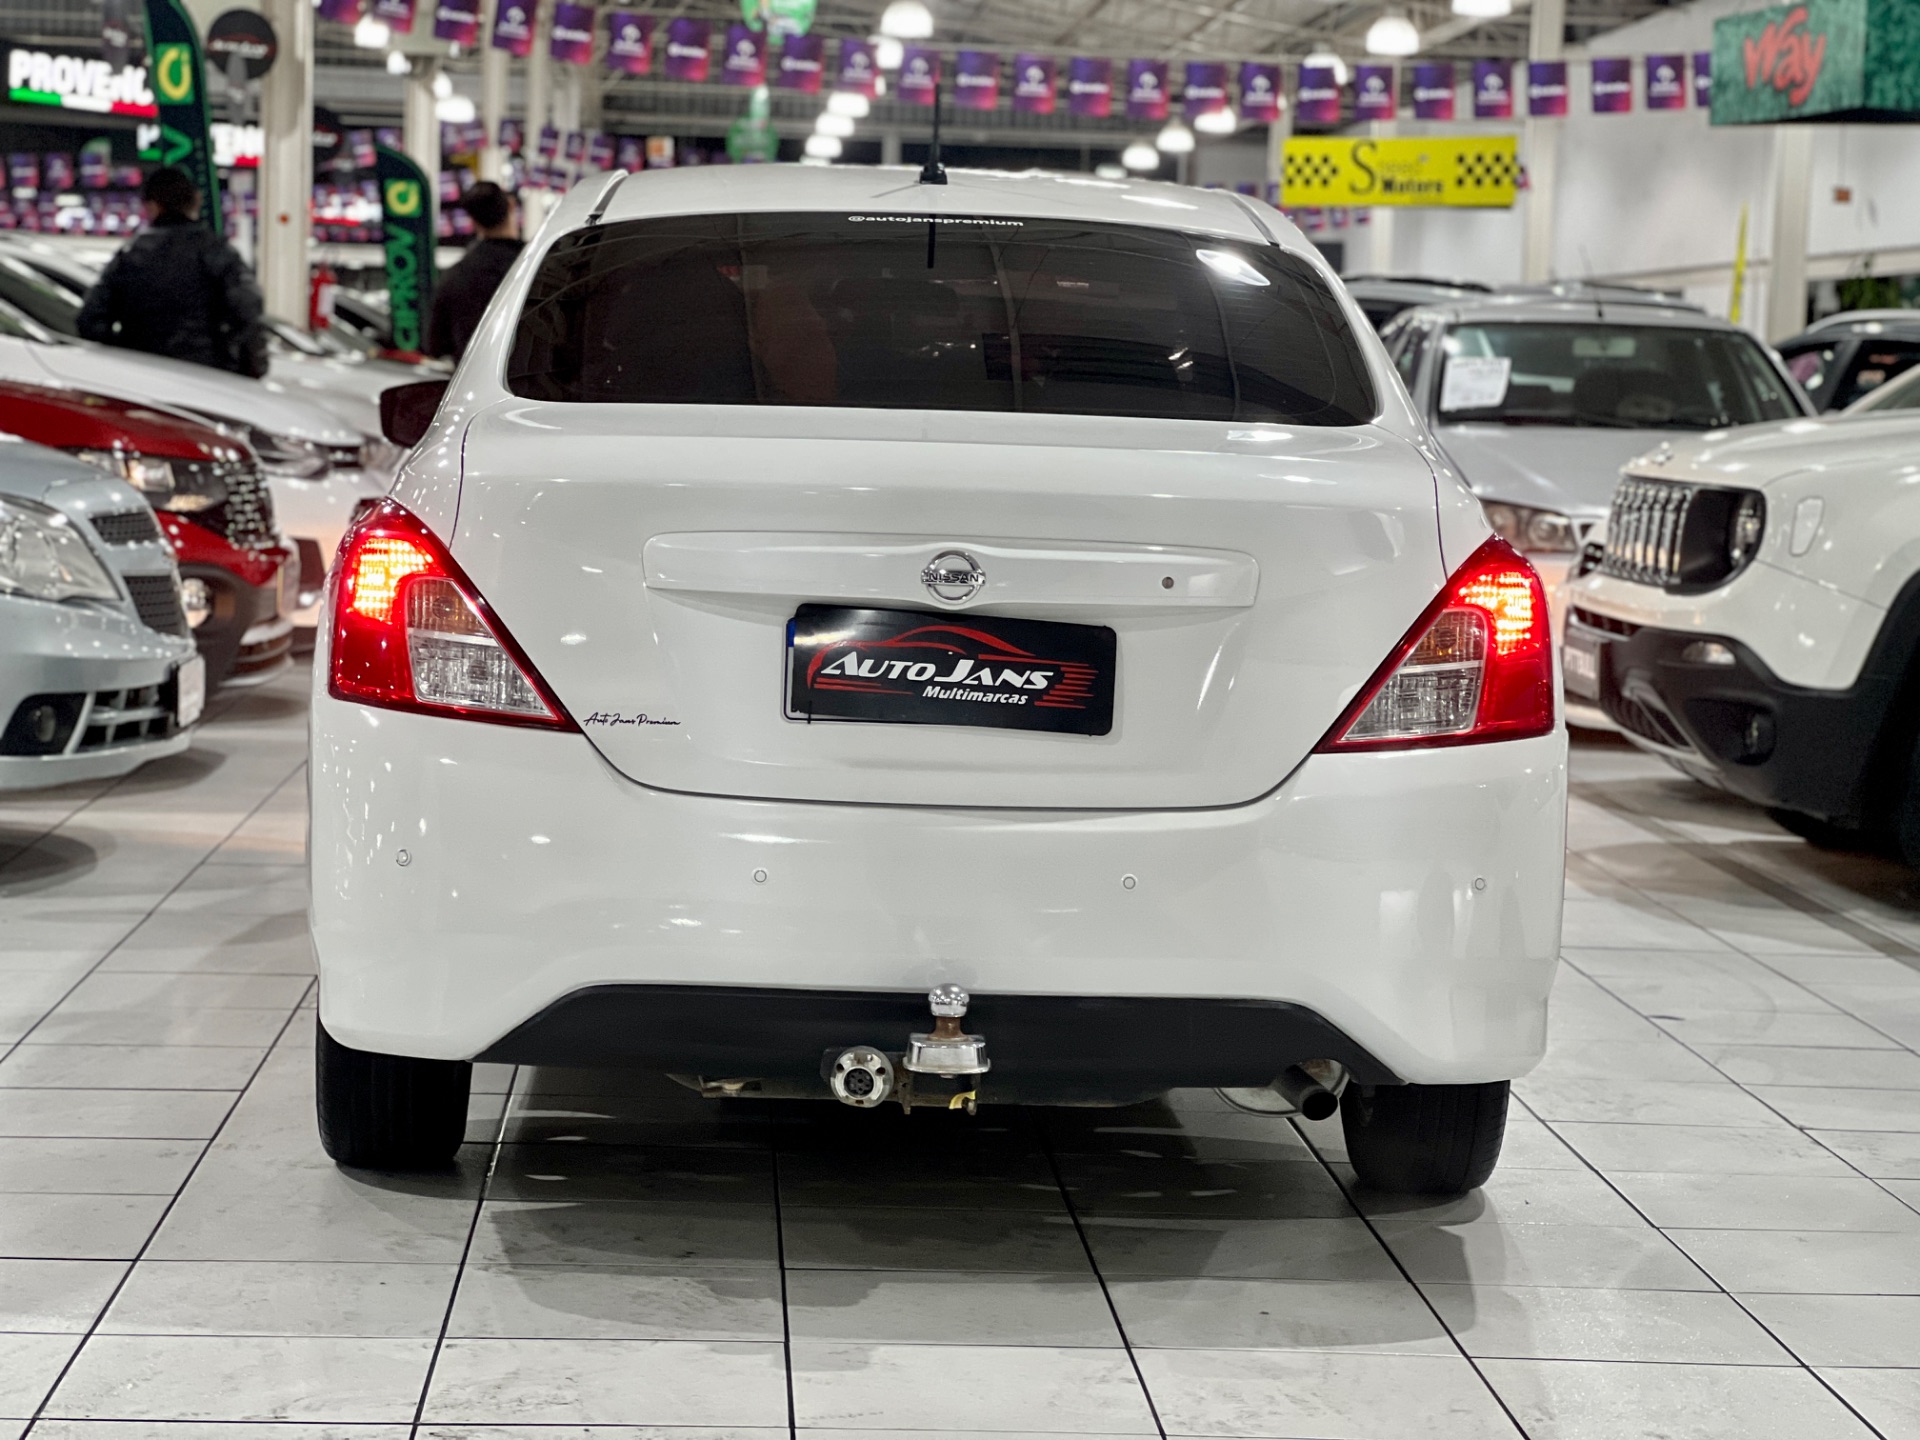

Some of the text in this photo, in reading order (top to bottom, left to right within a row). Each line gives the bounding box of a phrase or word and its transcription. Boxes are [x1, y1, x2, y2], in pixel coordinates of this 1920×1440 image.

[1743, 5, 1827, 107] Way
[848, 215, 1024, 227] @autojanspremium
[928, 572, 979, 582] NISSAN
[933, 652, 1054, 690] JANS
[922, 685, 1029, 706] Multimarcas
[636, 713, 681, 726] Premium
